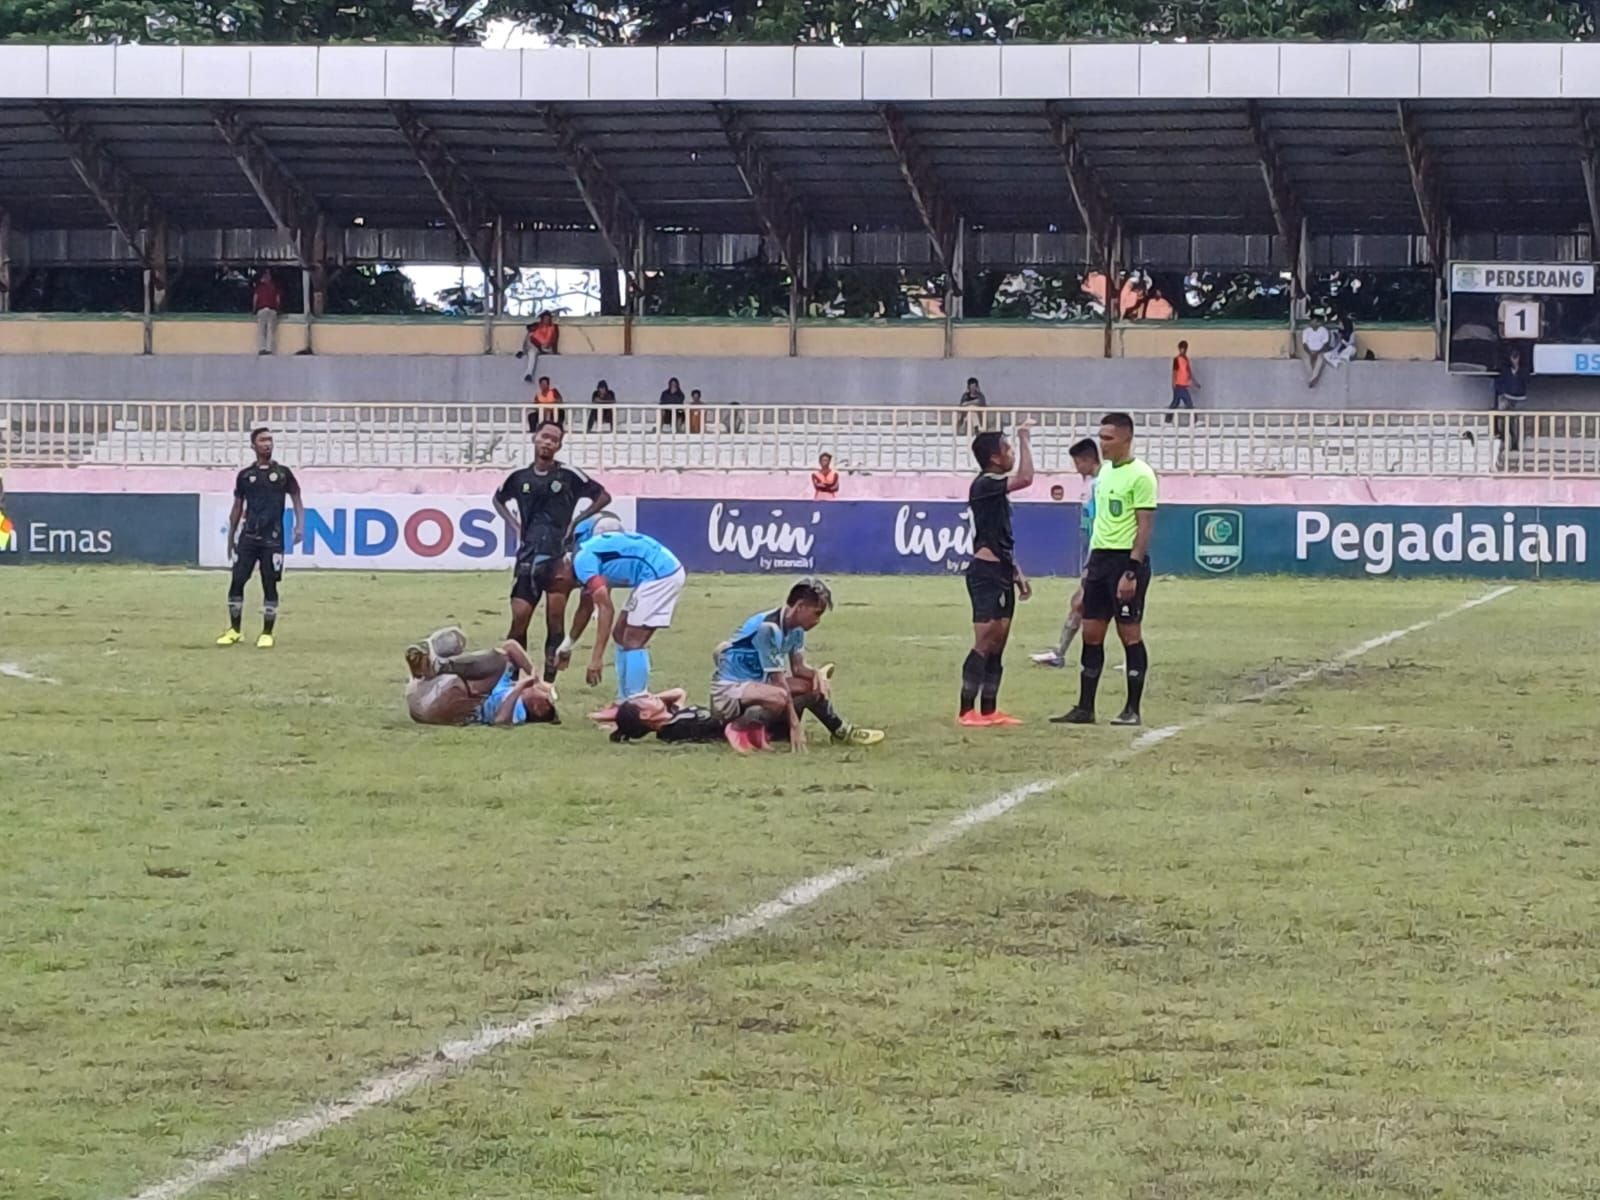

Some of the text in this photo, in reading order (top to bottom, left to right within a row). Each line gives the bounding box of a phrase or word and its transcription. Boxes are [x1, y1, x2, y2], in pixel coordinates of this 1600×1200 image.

[1484, 269, 1585, 289] PERSERANG
[1514, 308, 1527, 332] 1
[29, 522, 112, 553] Emas
[1296, 510, 1587, 574] Pegadaian
